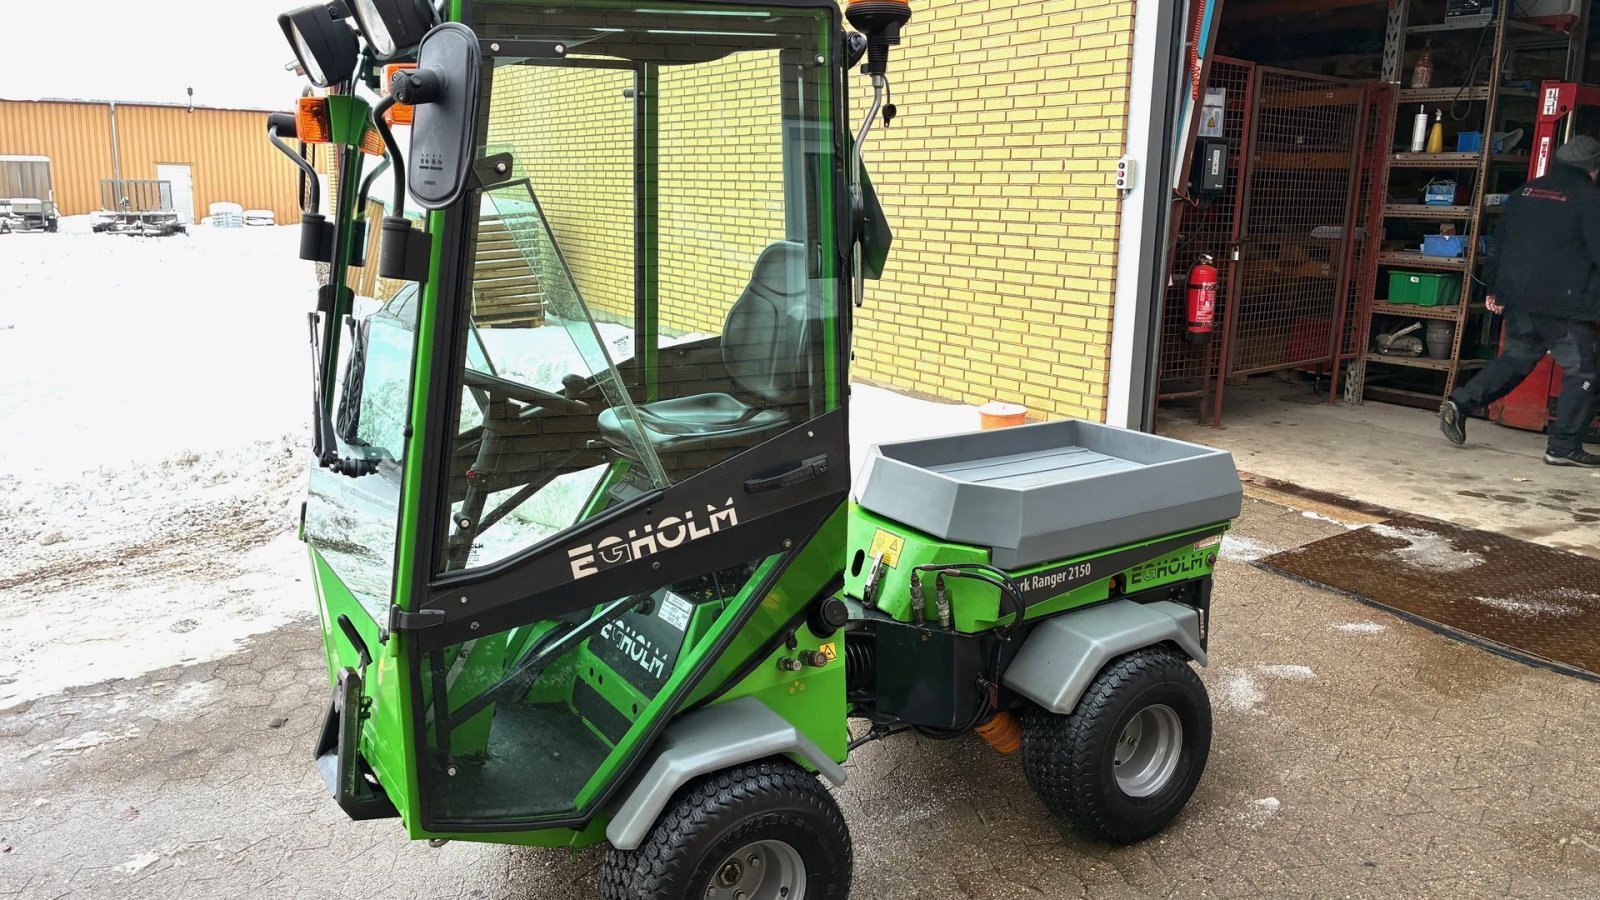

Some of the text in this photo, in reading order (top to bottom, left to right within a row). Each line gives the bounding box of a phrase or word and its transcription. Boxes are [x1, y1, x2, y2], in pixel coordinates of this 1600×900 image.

[568, 497, 738, 580] EGHOLM
[1032, 571, 1067, 590] Ranger
[1068, 562, 1091, 581] 2150
[1131, 552, 1204, 585] EGHOLM
